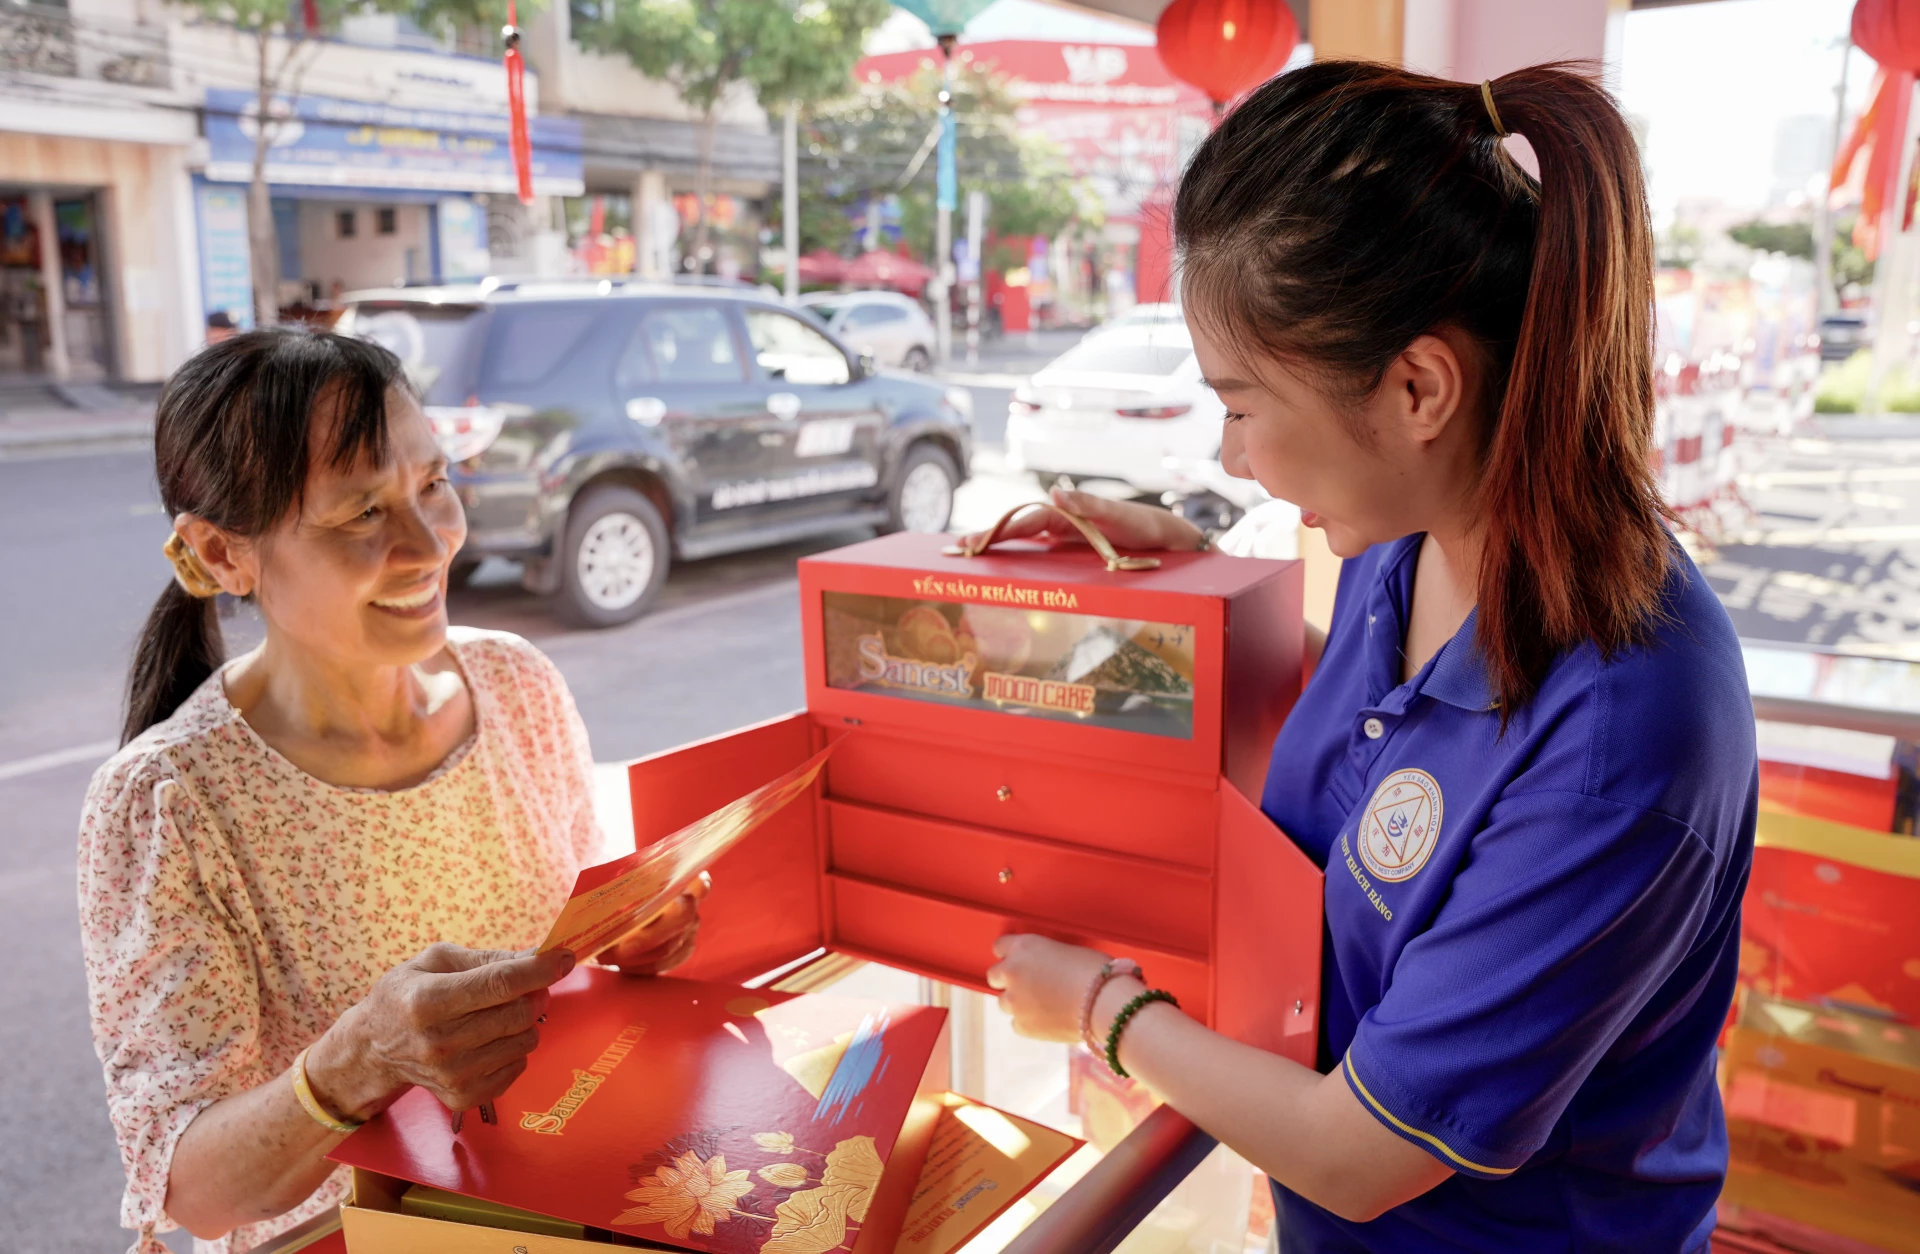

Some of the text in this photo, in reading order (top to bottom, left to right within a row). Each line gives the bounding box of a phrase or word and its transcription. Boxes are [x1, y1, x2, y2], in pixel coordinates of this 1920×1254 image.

[946, 578, 978, 599] SÀO
[981, 583, 1040, 606] KHÁNH
[1042, 587, 1079, 609] HÒA
[857, 632, 973, 697] Sanest
[986, 674, 1093, 714] MOON CAKE
[1345, 855, 1371, 894] KHÁCH
[1367, 888, 1393, 922] HÀNG
[1390, 861, 1416, 876] COMPANY
[519, 1069, 606, 1135] Sanest
[588, 1041, 634, 1075] MOON
